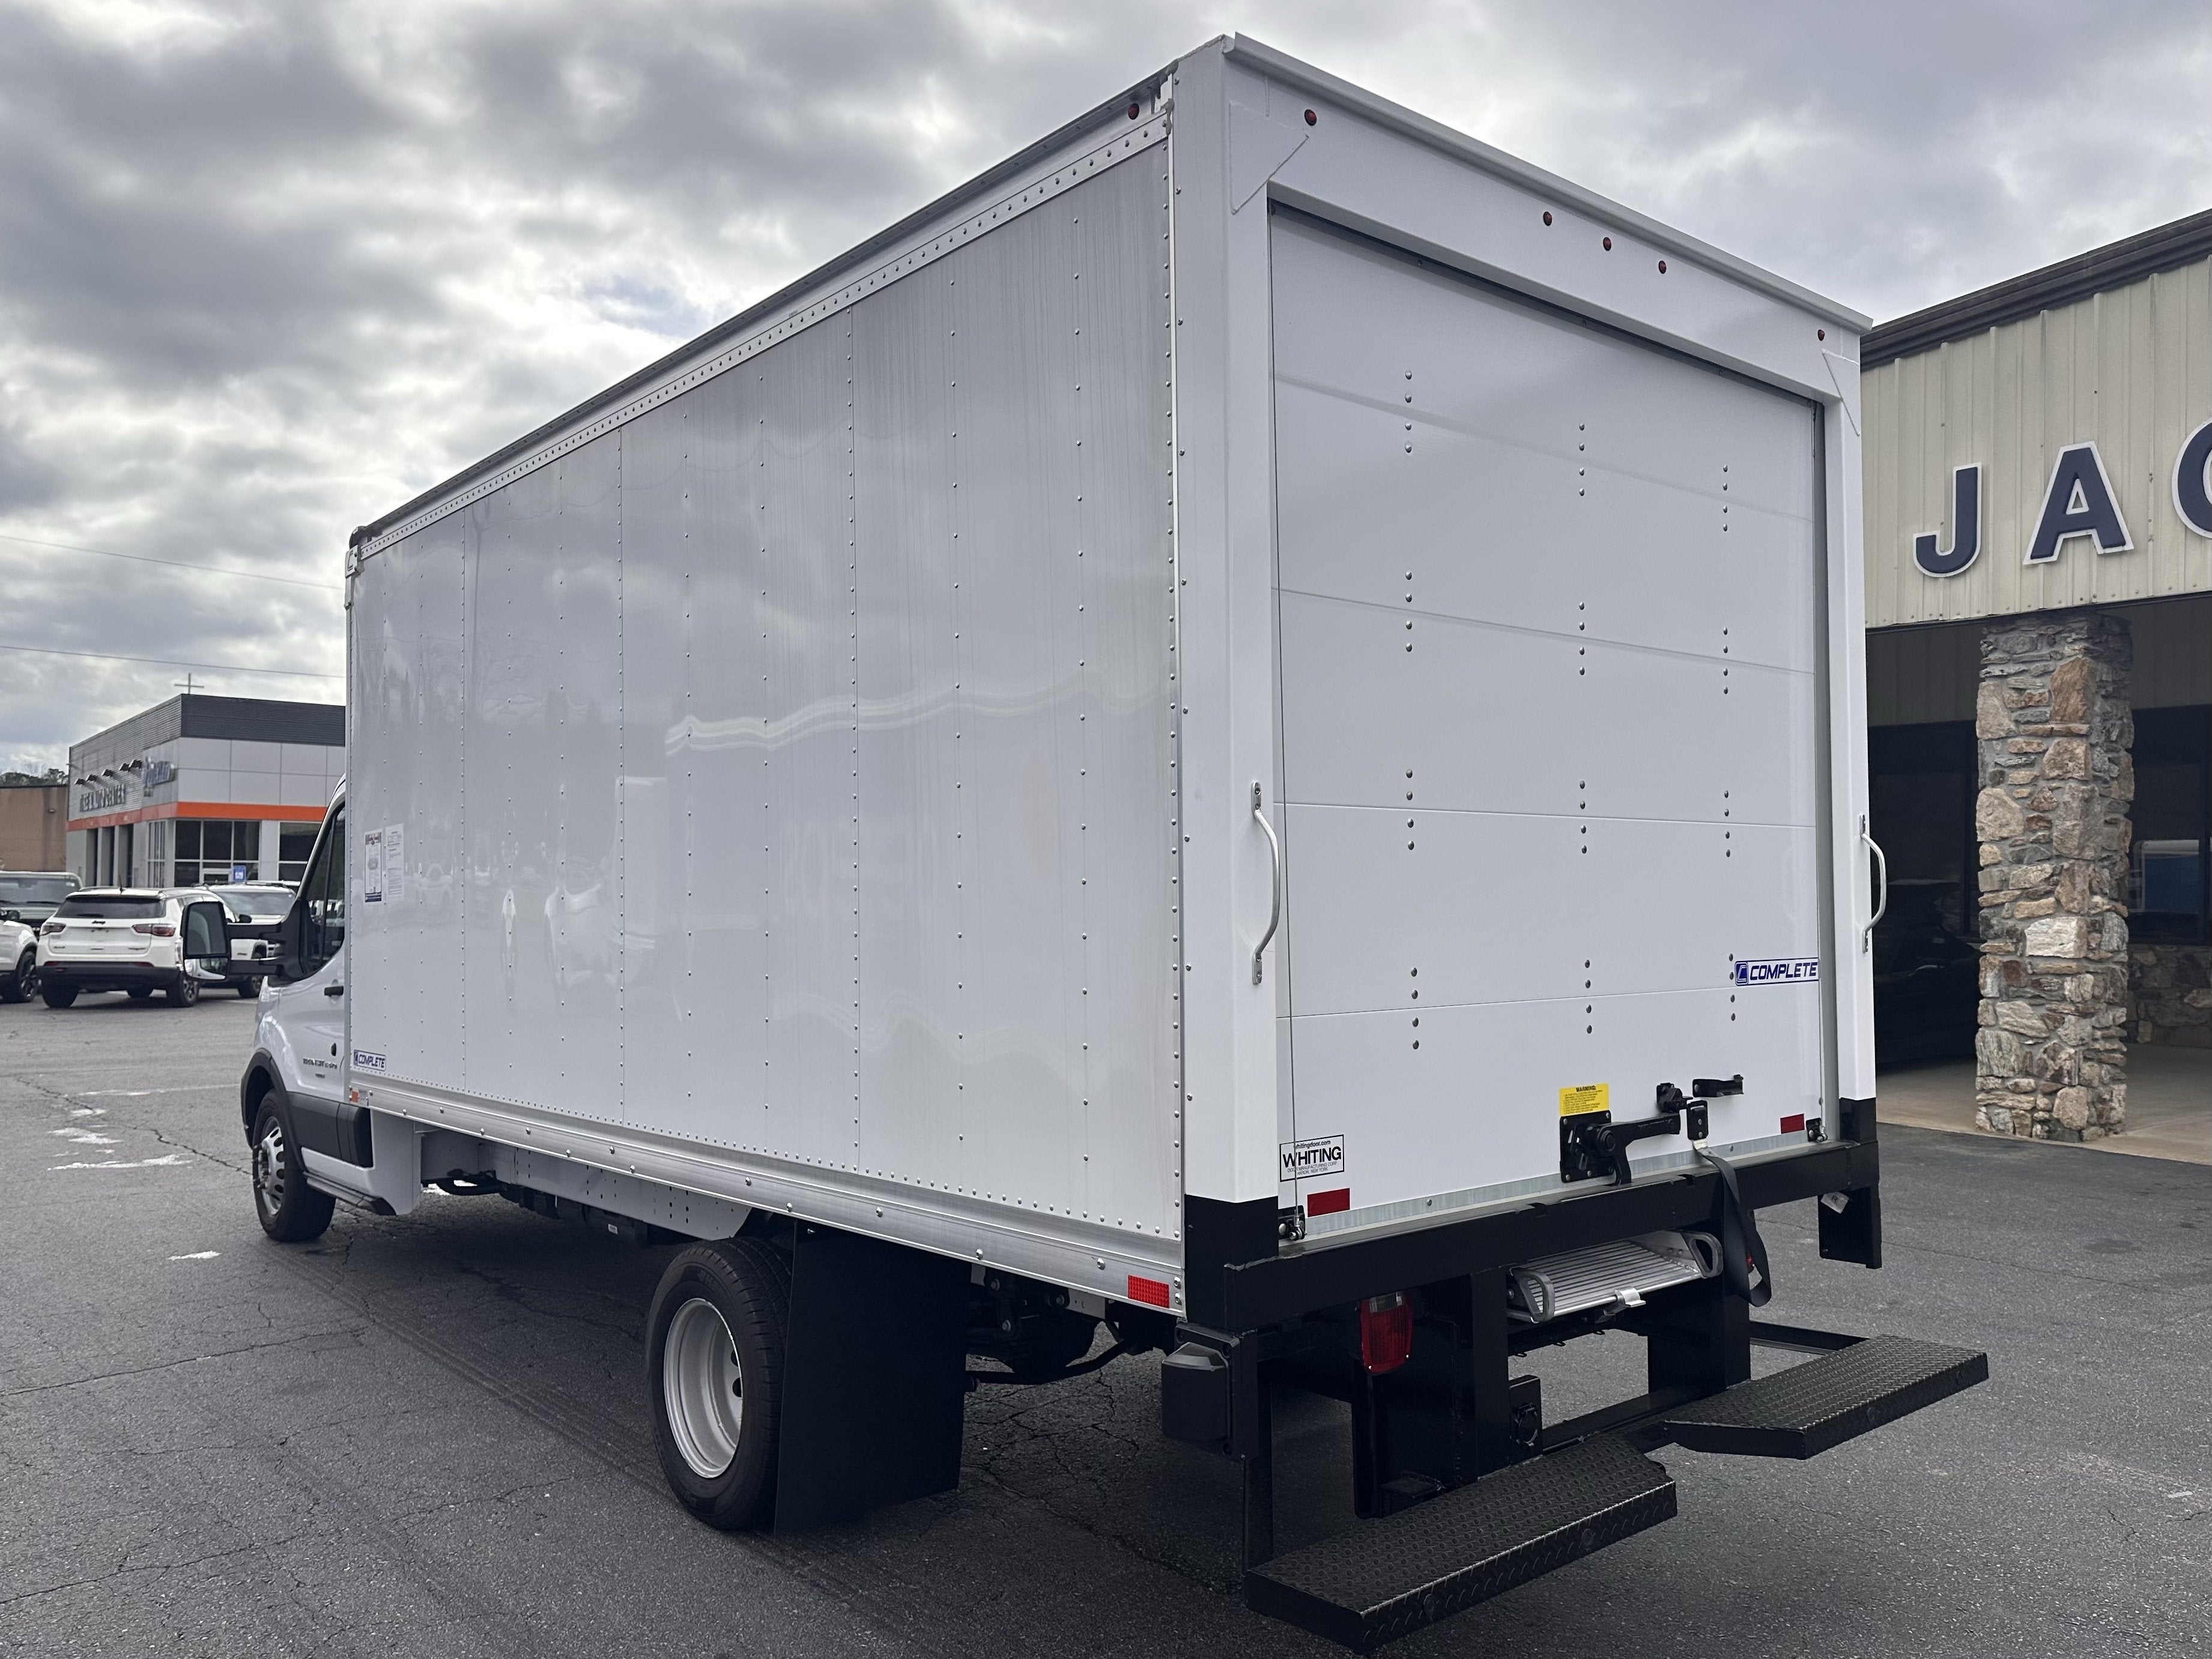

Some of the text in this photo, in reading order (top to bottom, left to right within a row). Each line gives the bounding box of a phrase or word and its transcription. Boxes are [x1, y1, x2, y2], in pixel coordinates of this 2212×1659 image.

[1750, 962, 1818, 980] COMPLETE
[359, 1054, 386, 1068] COMPLETE
[1294, 1140, 1331, 1150] hitingdoor.com
[1282, 1146, 1342, 1168] WHITING
